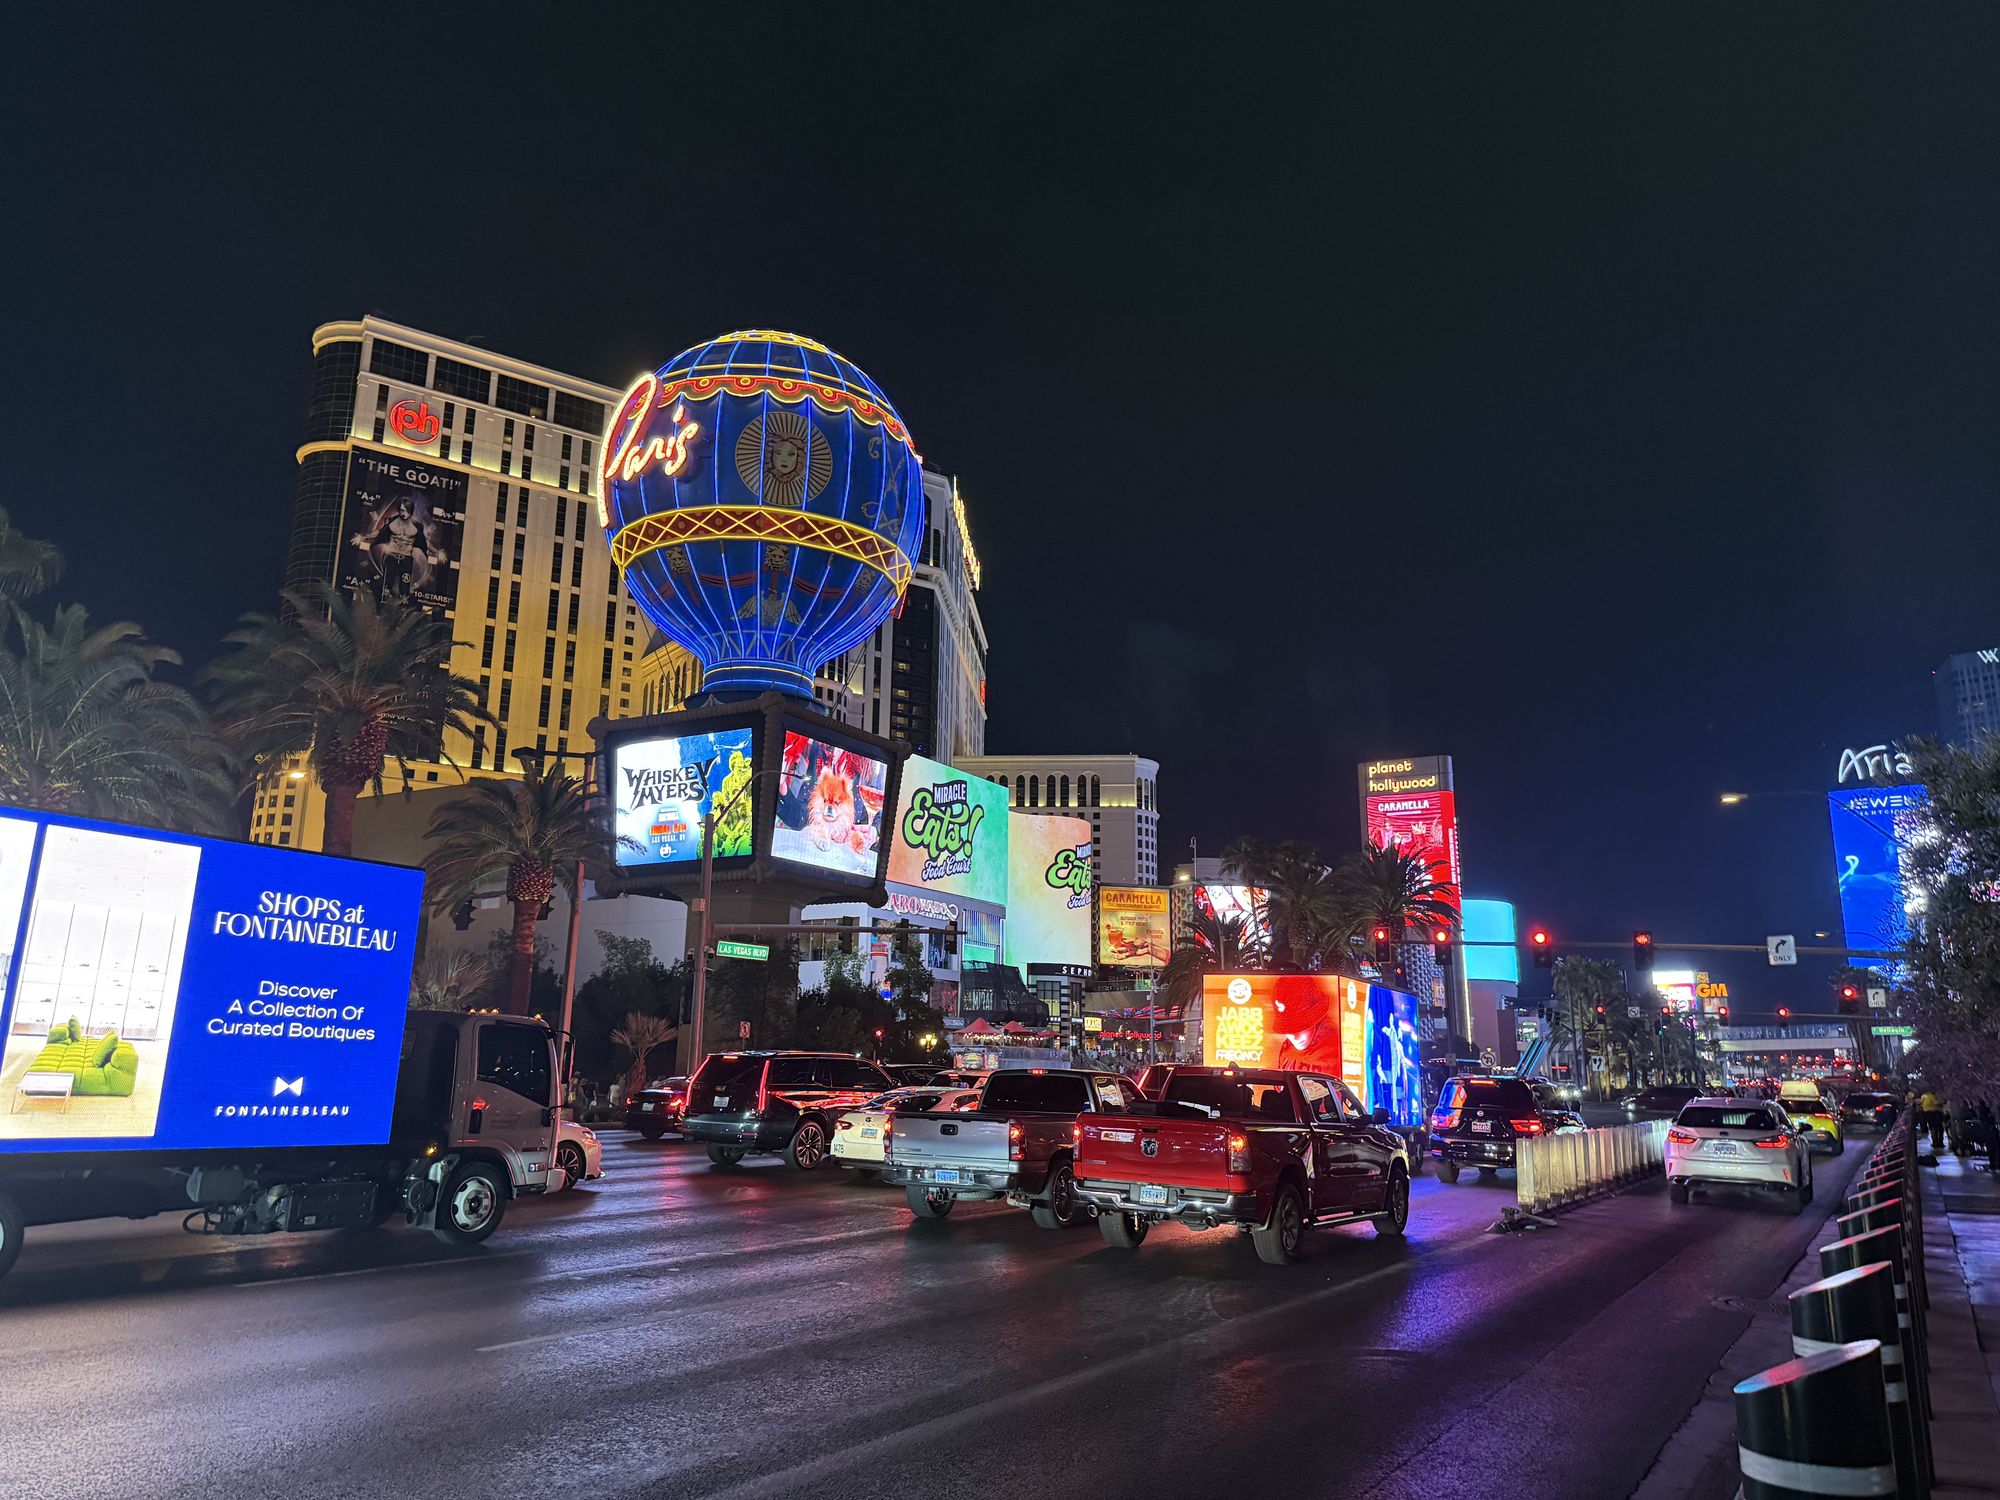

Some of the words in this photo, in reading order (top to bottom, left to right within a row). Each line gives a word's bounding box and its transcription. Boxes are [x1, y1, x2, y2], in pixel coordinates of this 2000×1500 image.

[394, 401, 439, 441] ph
[597, 373, 700, 528] Paris
[405, 468, 461, 490] GOAT!”
[1368, 760, 1413, 777] planet
[1839, 745, 1912, 783] Aria
[621, 754, 720, 810] WHISKEY
[1369, 775, 1436, 792] hollywood
[632, 781, 705, 811] MYERS
[934, 784, 966, 804] MIRACLE
[1378, 800, 1430, 812] CARAMELLA
[902, 789, 985, 859] Eats!
[922, 860, 946, 880] Food
[945, 856, 972, 876] Court
[258, 891, 342, 921] SHOPS
[343, 904, 365, 924] at
[1105, 892, 1162, 905] CARAMELLA
[214, 911, 397, 951] FONTAINEBLEAU
[719, 944, 732, 955] LAS
[733, 946, 751, 956] VEGAS
[753, 948, 767, 958] BLVD
[259, 980, 338, 999] Discover
[227, 999, 243, 1014] A
[248, 1000, 337, 1019] Collection
[342, 1006, 365, 1021] Of
[1216, 1006, 1264, 1021] JABB
[207, 1018, 284, 1037] Curated
[288, 1022, 375, 1042] Boutiques
[1099, 1031, 1123, 1039] planet
[1217, 1020, 1264, 1035] AWOC
[1216, 1035, 1264, 1049] KEEZ
[215, 1105, 350, 1116] FONTAINEBLEAU
